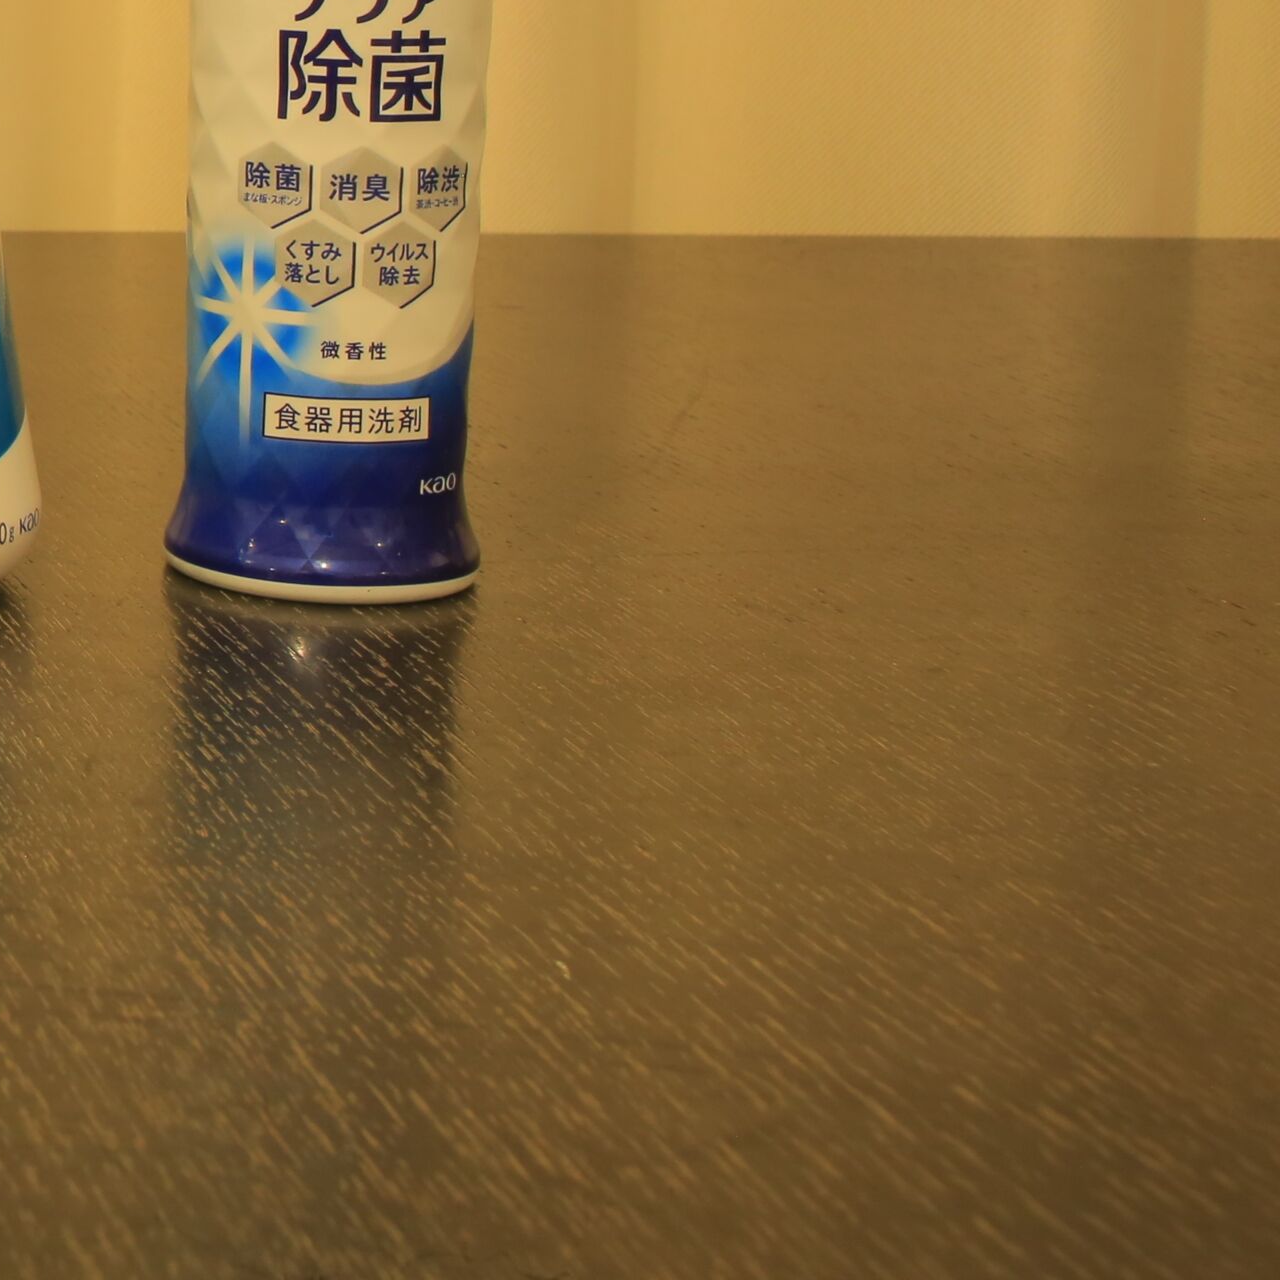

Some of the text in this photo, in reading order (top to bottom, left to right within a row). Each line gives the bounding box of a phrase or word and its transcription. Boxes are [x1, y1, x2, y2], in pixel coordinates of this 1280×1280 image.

[277, 29, 446, 122] 除菌
[244, 161, 302, 192] 除菌
[328, 173, 390, 202] 消臭
[417, 165, 460, 195] 除渋
[285, 240, 342, 260] くすみ
[370, 242, 429, 262] ウイルス
[284, 261, 340, 285] 落とし
[379, 266, 421, 286] 除去
[320, 340, 387, 361] 微香性
[274, 403, 423, 434] 食器用洗剤
